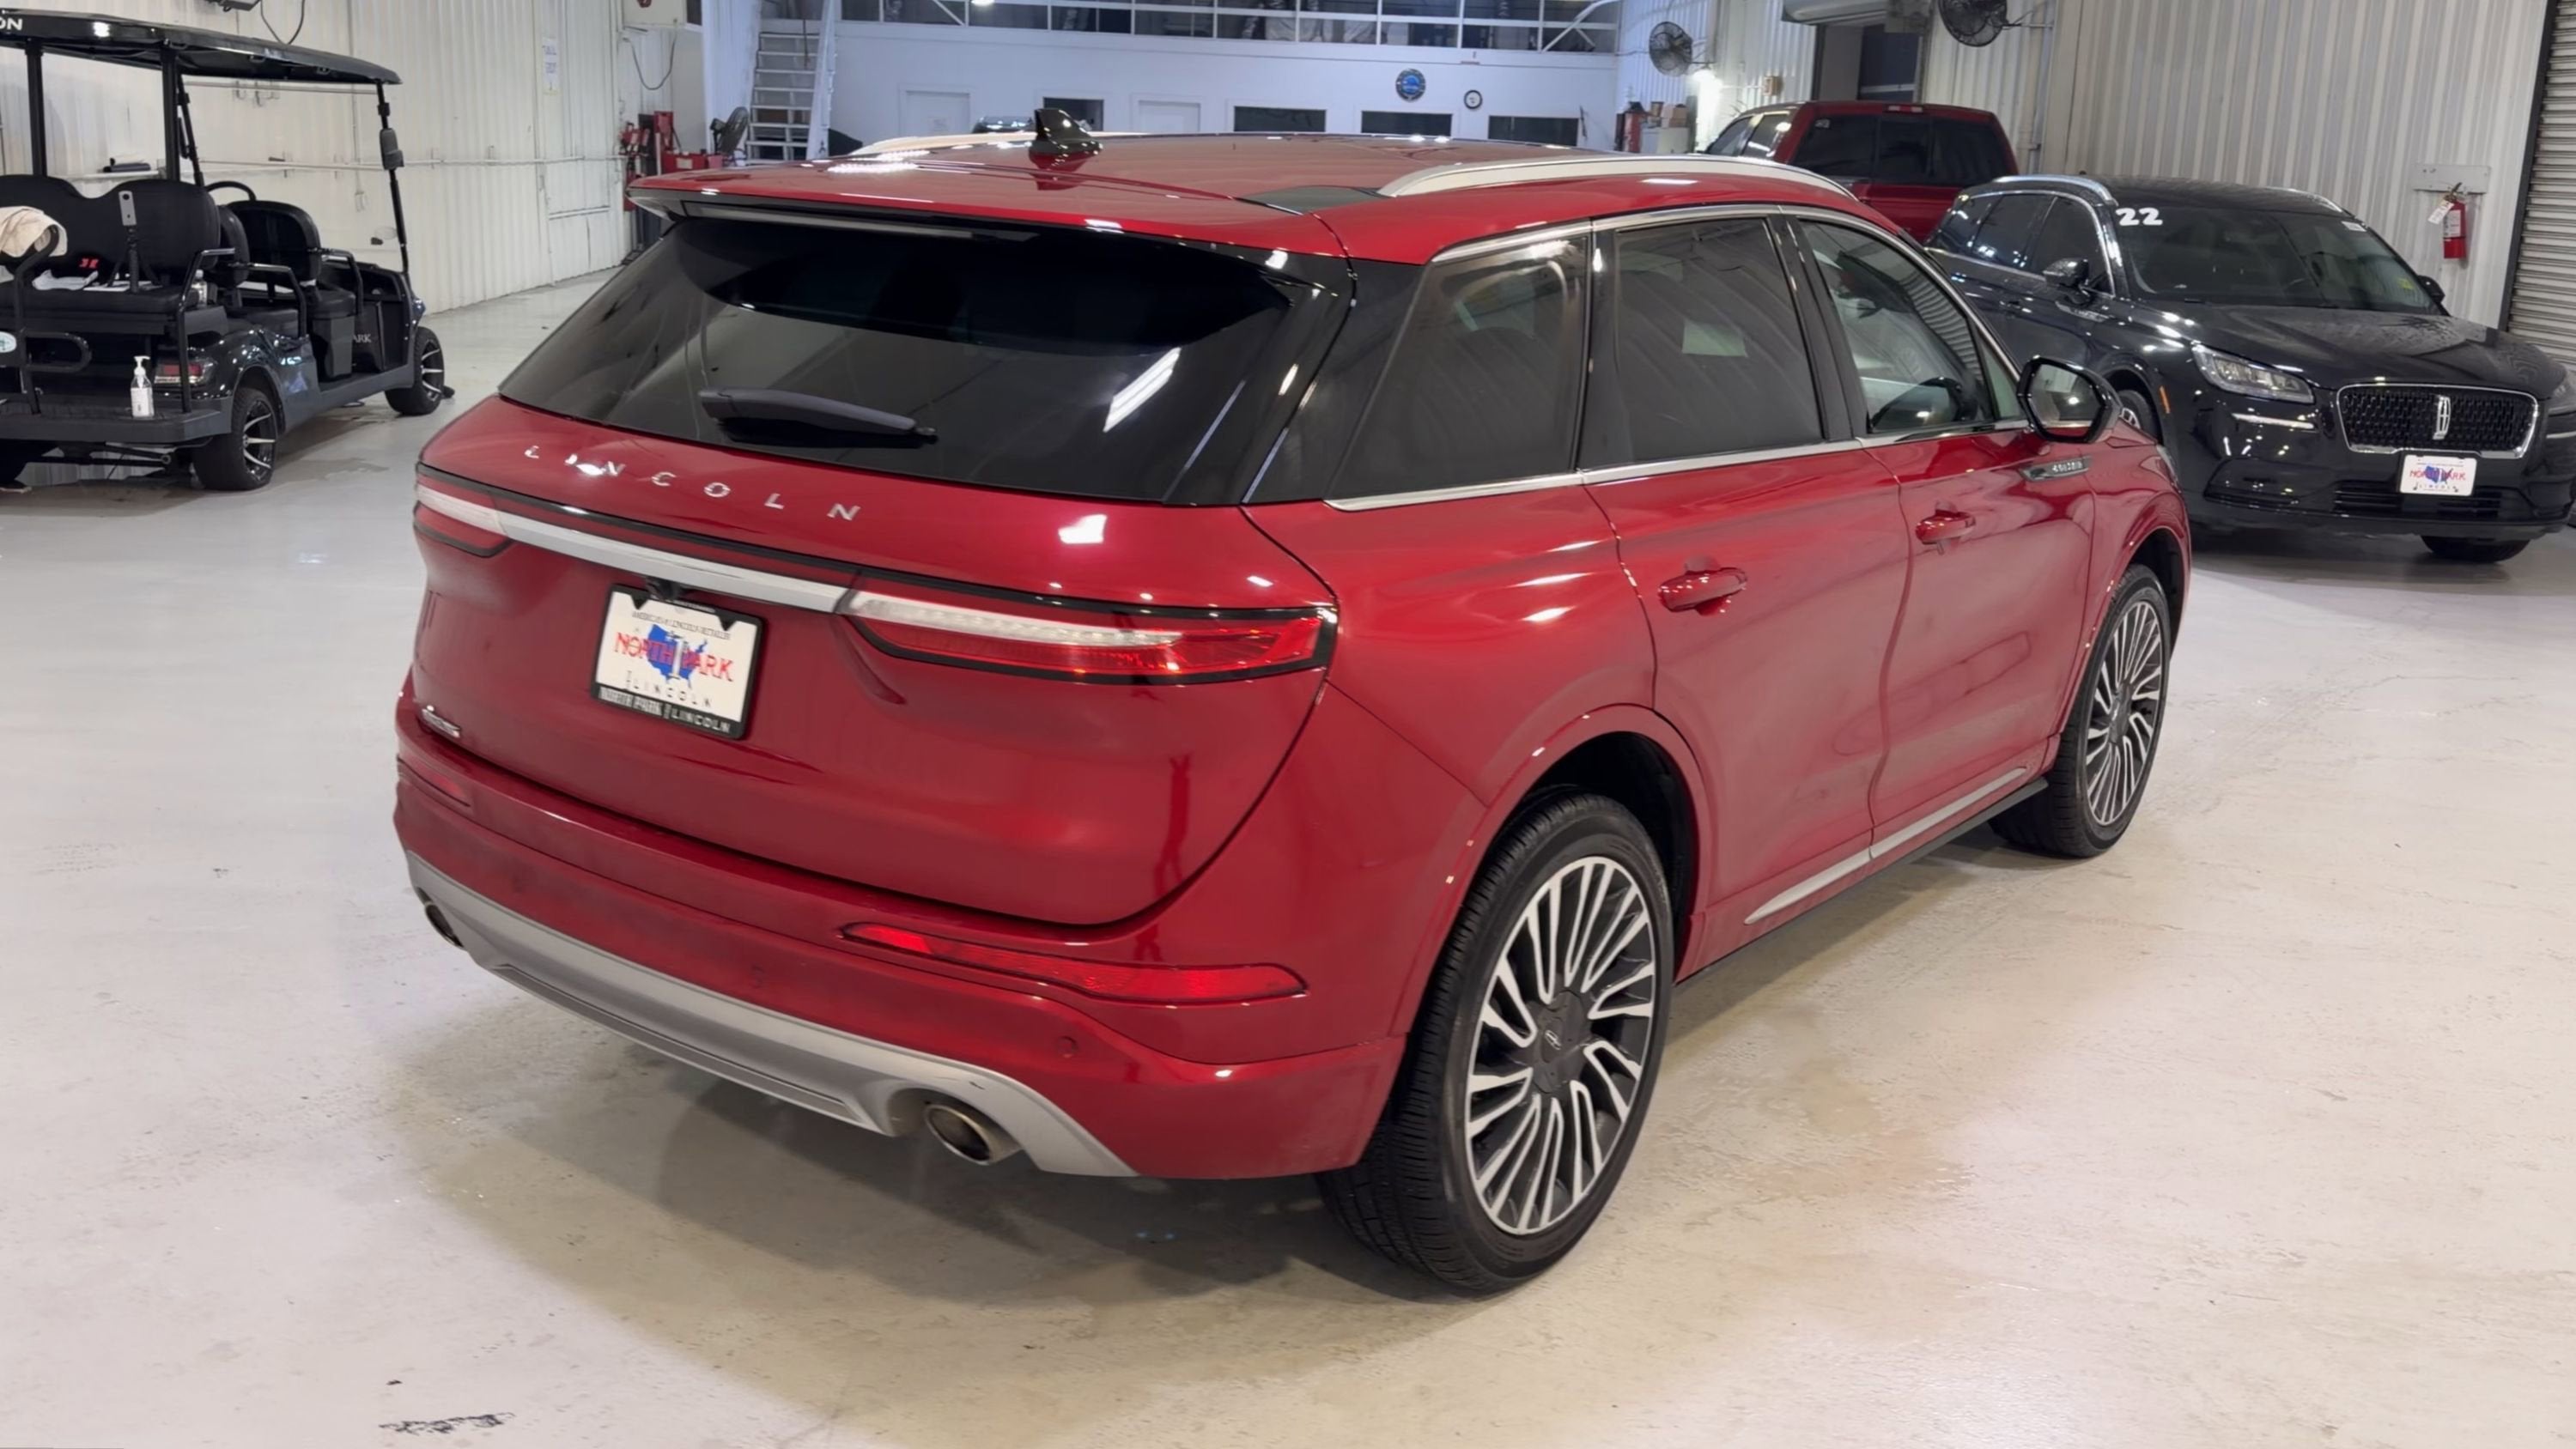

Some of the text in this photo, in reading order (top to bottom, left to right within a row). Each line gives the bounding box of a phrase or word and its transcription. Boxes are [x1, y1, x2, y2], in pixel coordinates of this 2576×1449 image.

[2115, 207, 2163, 226] 22
[524, 445, 862, 522] LINCOLN
[614, 632, 735, 682] NORTH PARK
[633, 678, 713, 708] LINCOLN
[671, 707, 732, 734] LINCOLN
